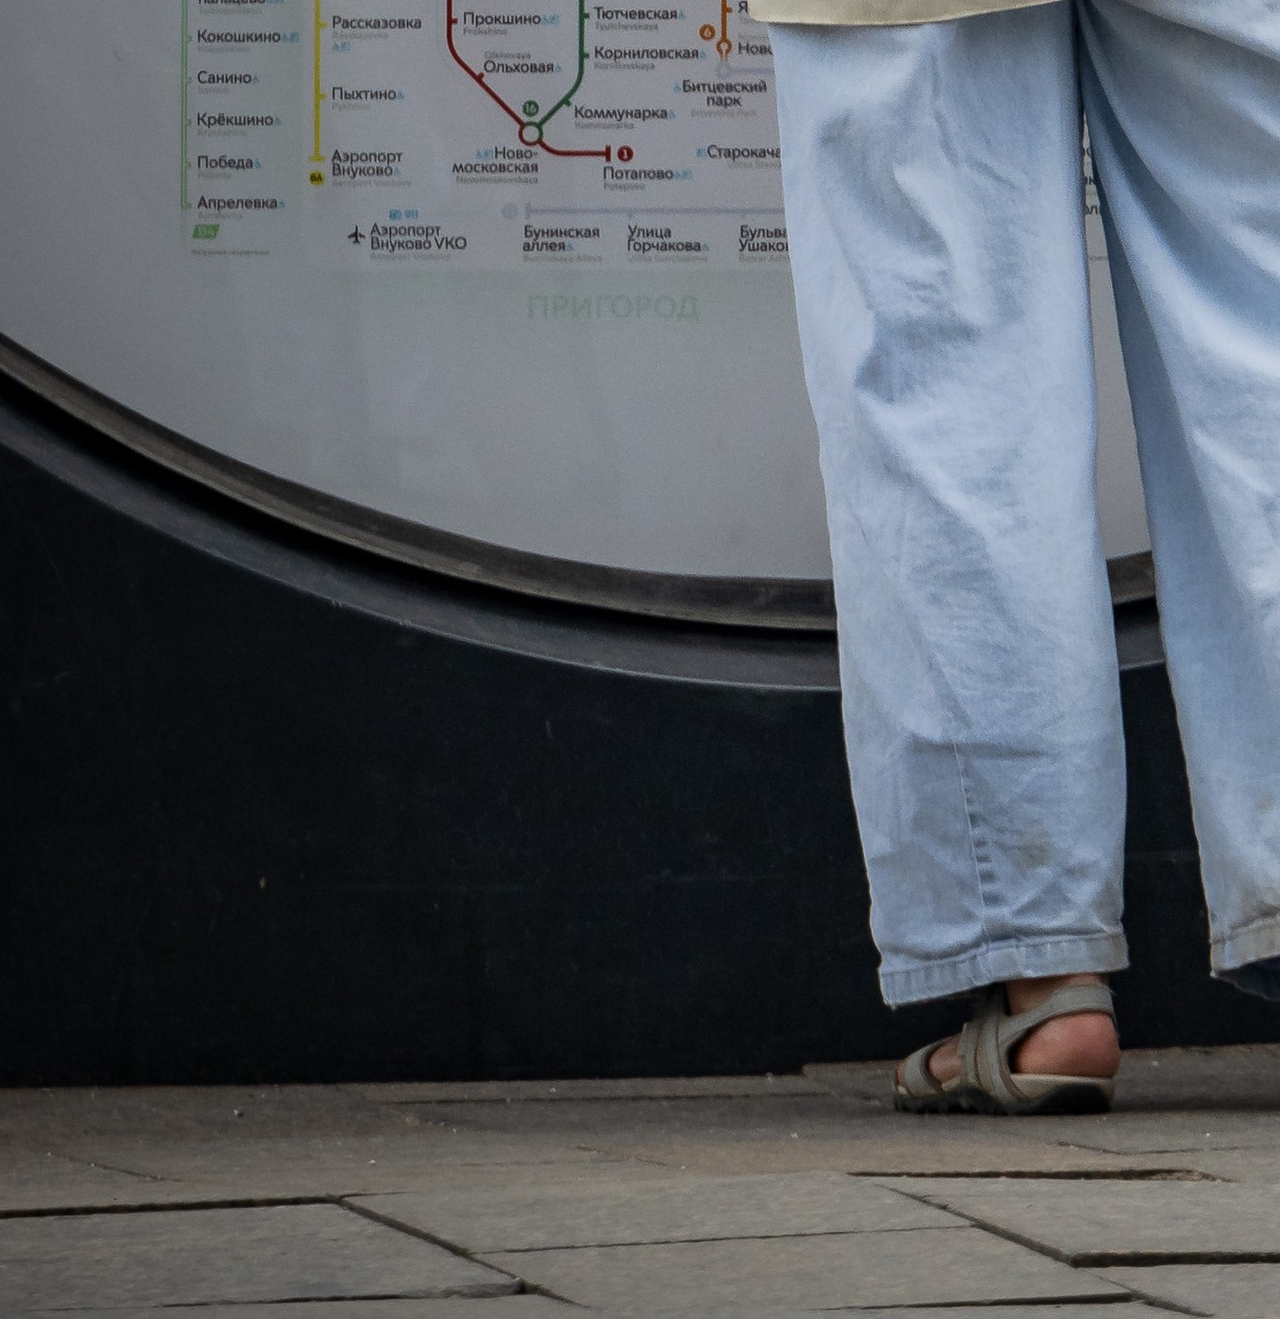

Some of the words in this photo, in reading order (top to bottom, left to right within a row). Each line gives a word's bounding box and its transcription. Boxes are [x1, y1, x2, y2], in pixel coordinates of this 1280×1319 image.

[332, 16, 422, 29] Рассказовка
[574, 106, 668, 122] Коммунарка
[197, 196, 278, 212] Апрелевка
